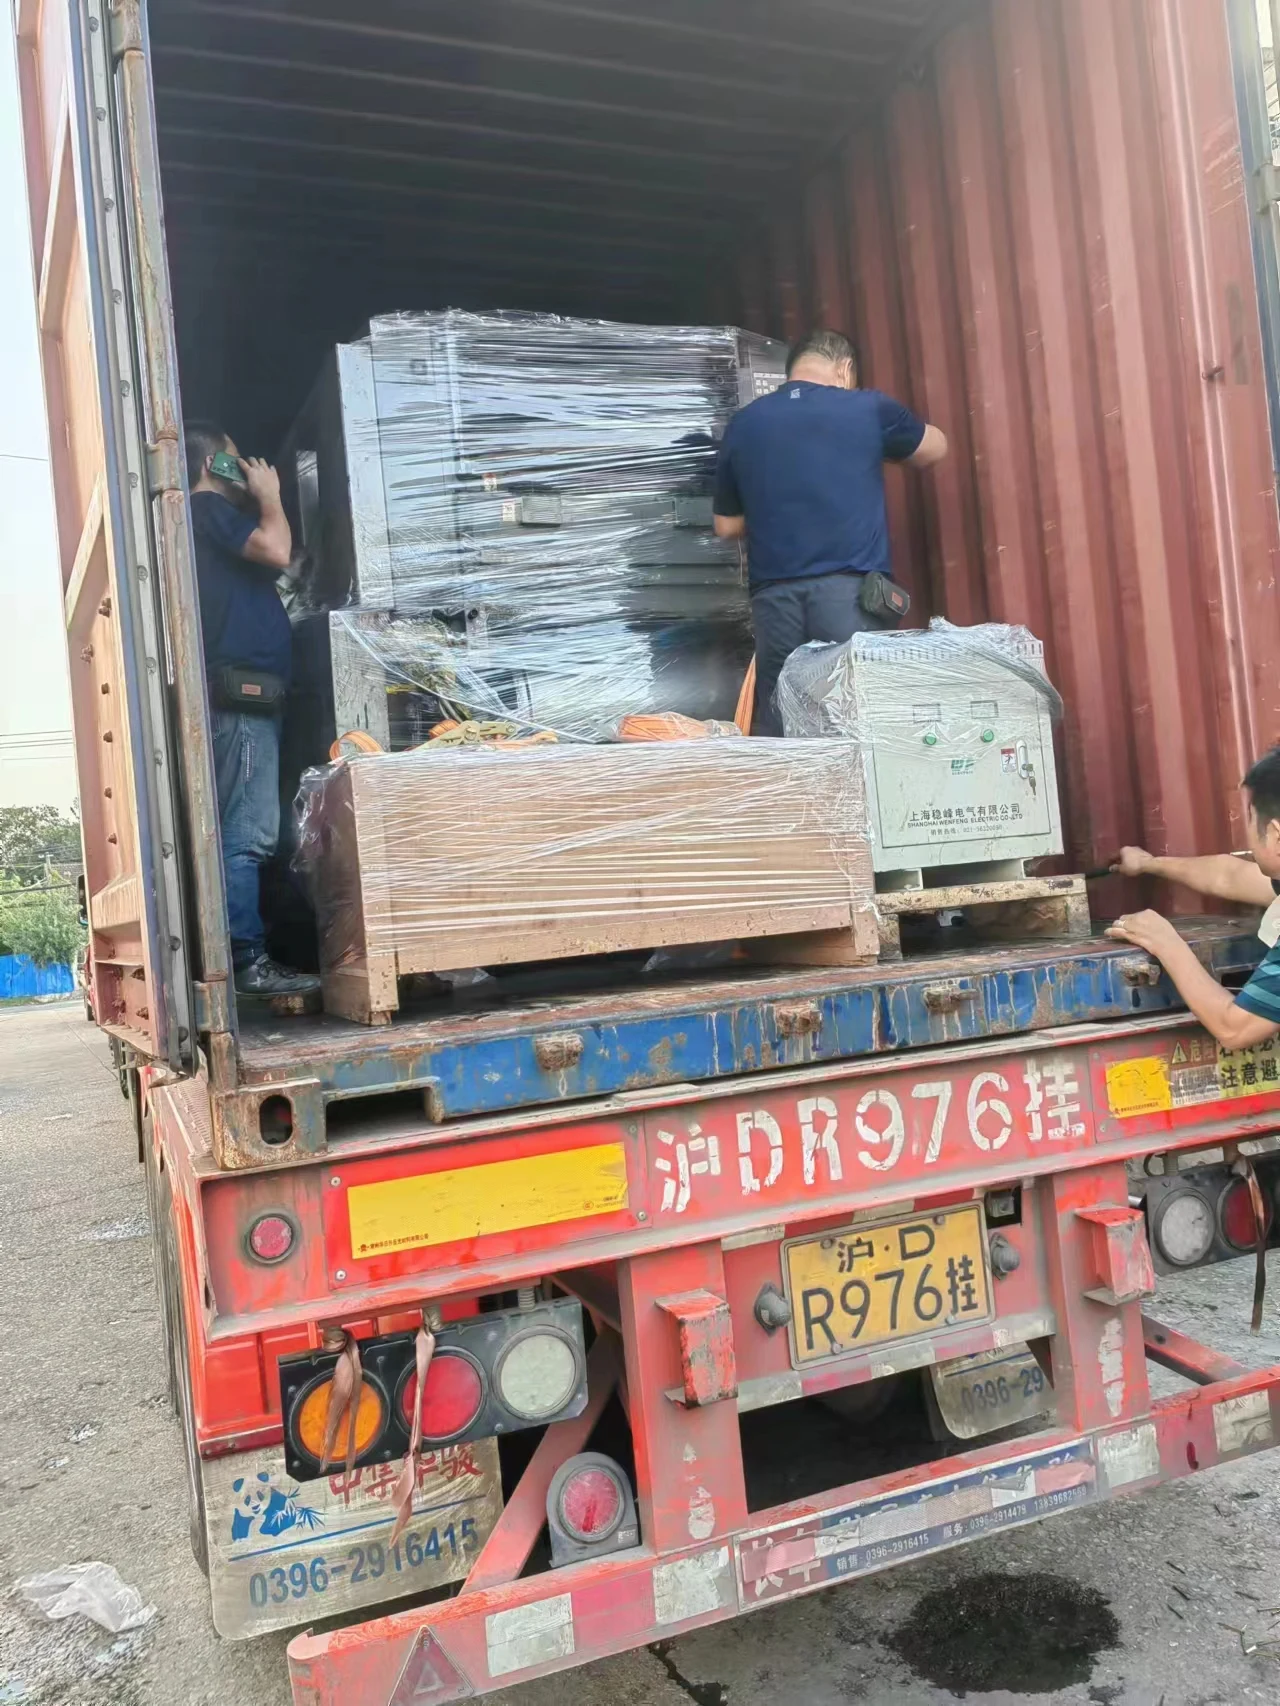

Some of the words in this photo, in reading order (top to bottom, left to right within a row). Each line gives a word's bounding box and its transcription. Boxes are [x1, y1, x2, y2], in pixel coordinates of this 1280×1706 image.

[907, 820, 938, 828] SHANGHAI
[939, 817, 968, 826] WENFENG
[970, 815, 999, 823] ELECTRIC
[909, 803, 1020, 822] 上海稳峰电气有限公司
[655, 1058, 1086, 1213] 沪DR976挂
[801, 1254, 979, 1350] R976挂
[250, 1517, 479, 1608] 0396-2916415
